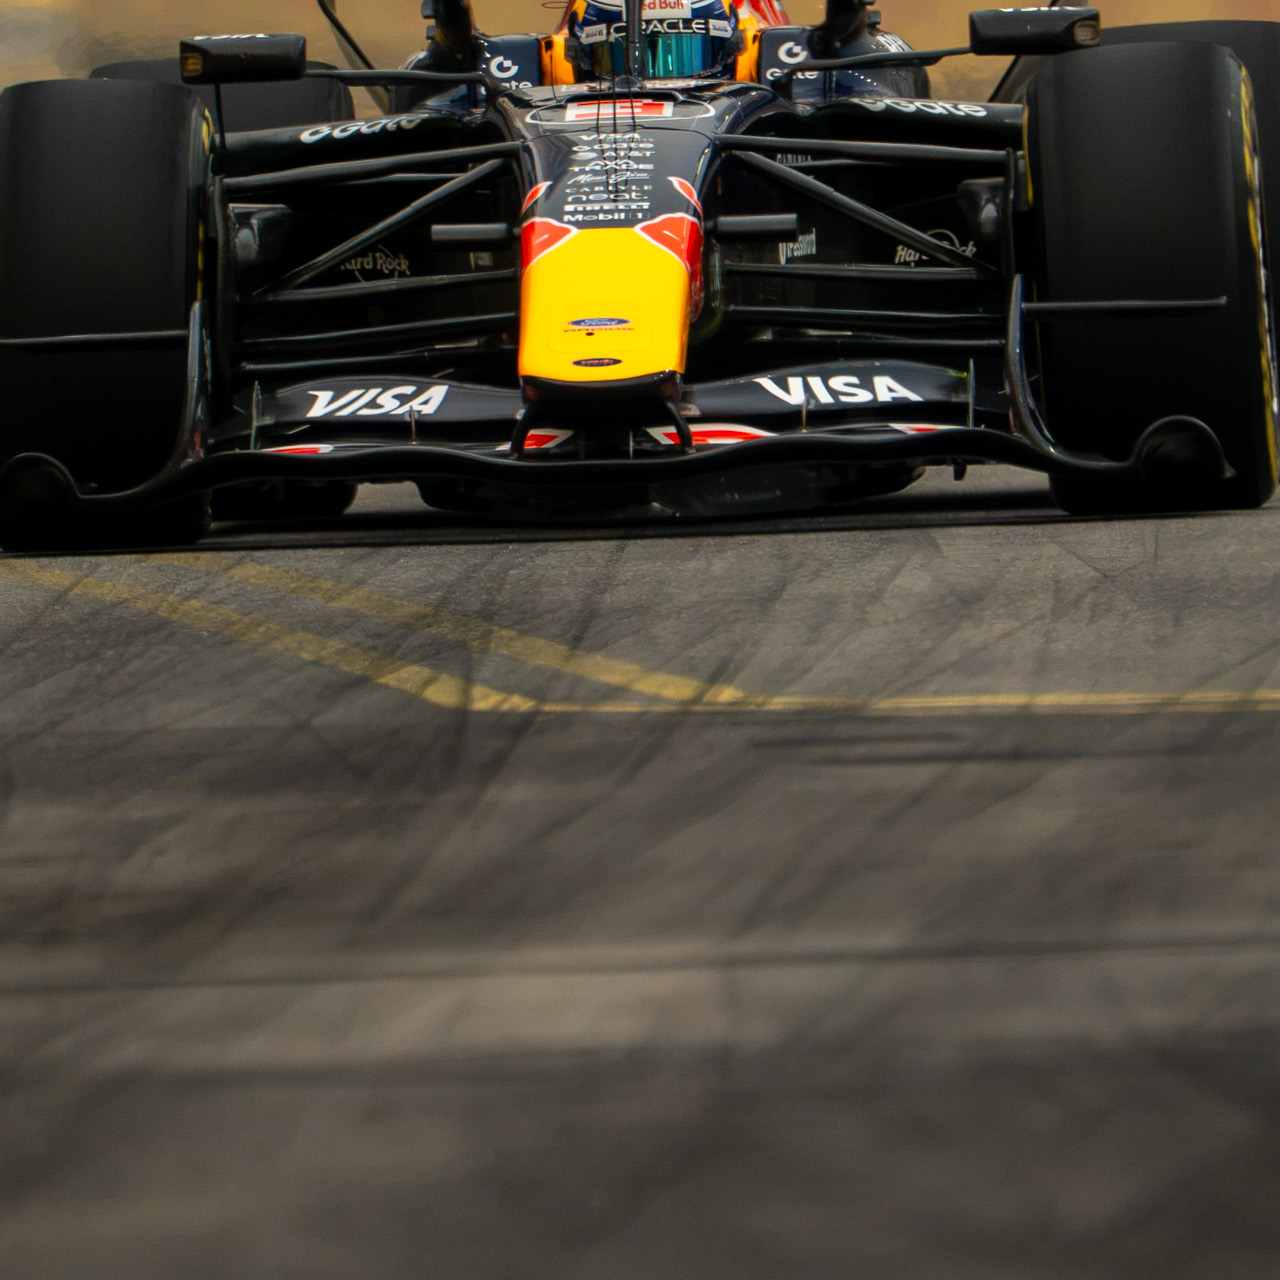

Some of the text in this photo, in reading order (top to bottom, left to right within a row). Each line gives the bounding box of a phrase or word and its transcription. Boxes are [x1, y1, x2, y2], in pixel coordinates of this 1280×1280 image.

[610, 19, 707, 37] OACLE
[563, 212, 626, 222] Mobil
[374, 251, 410, 274] Rock
[306, 385, 450, 418] VISA
[752, 375, 925, 406] VISA
